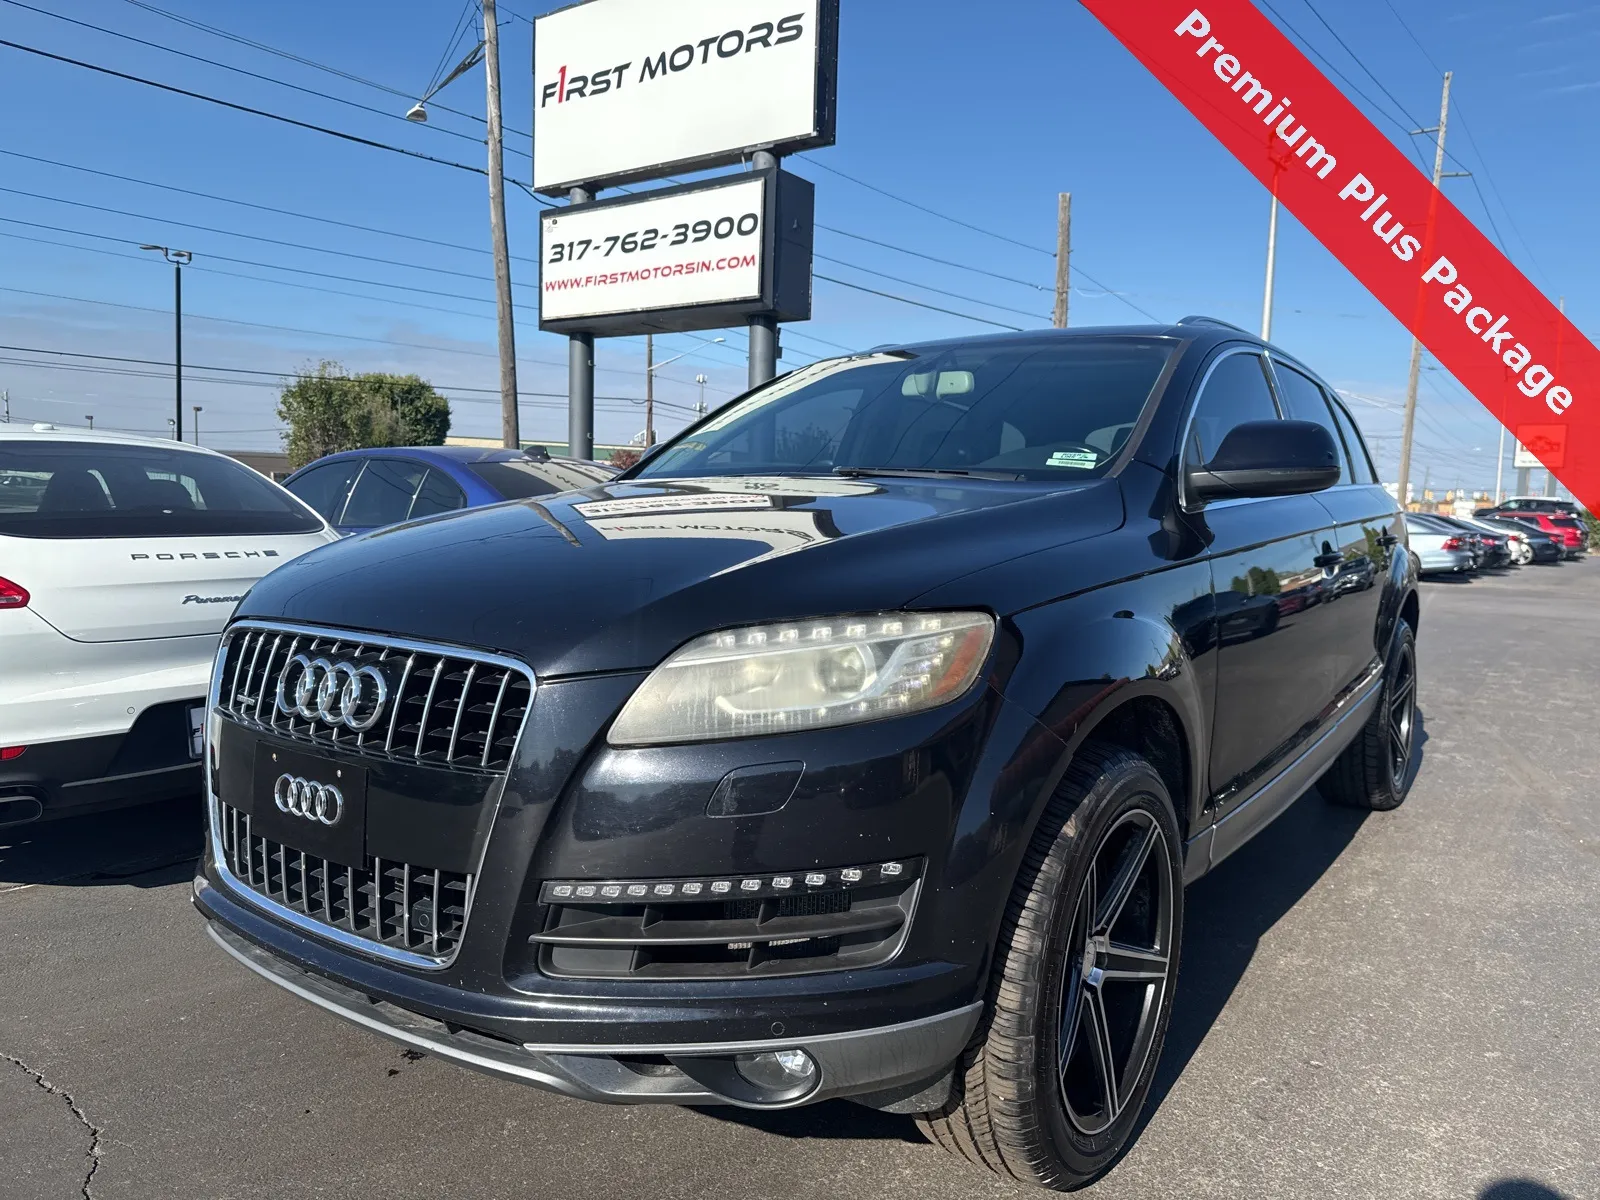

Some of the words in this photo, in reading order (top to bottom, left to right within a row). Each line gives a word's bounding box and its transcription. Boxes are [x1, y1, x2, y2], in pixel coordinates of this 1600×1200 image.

[638, 12, 805, 84] MOTORS
[547, 212, 759, 265] 317-762-3900
[545, 254, 757, 292] WWW.FIRSTMOTORSIN.COM
[130, 549, 280, 561] PORSCHE
[182, 594, 244, 605] Paname
